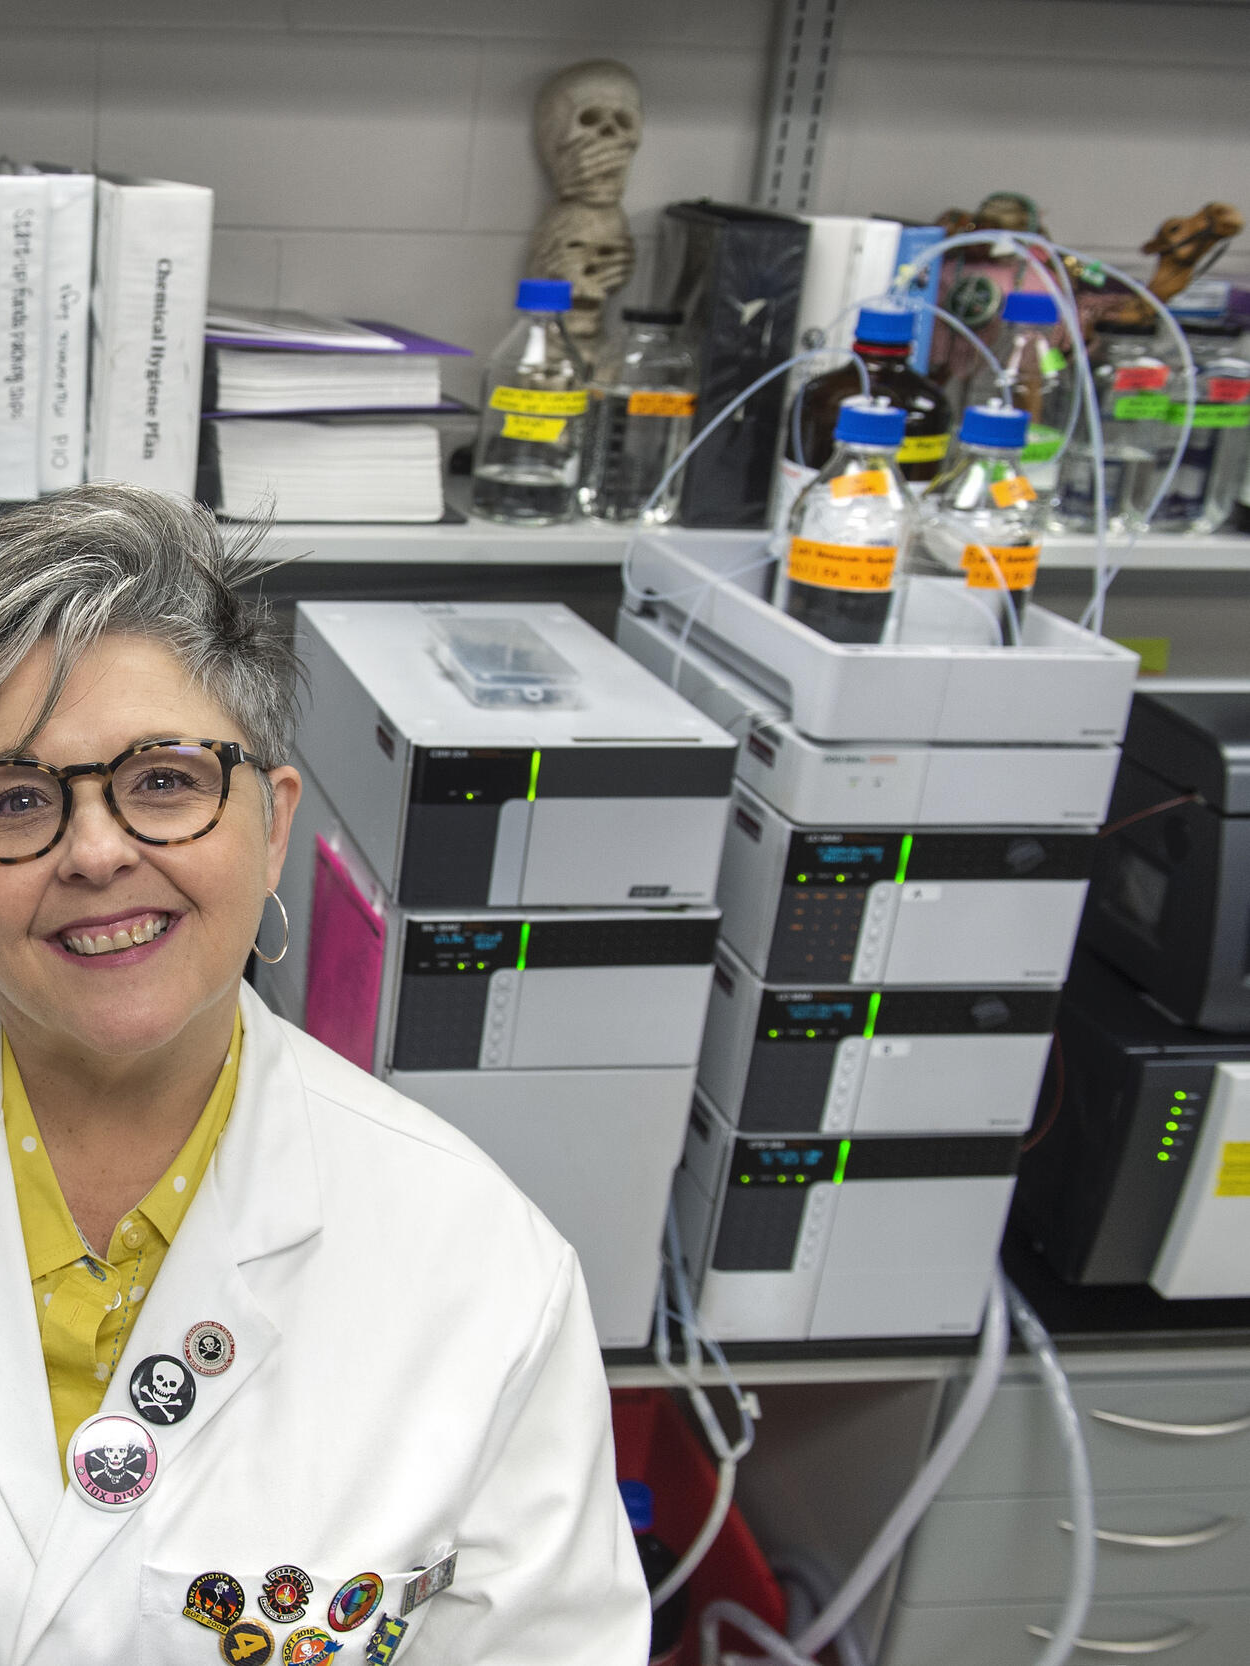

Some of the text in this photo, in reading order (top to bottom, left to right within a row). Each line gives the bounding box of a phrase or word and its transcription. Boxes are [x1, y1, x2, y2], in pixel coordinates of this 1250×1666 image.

[142, 257, 173, 460] Chemical Hygiene Plan
[84, 1480, 145, 1503] TOX DIVA
[270, 1568, 293, 1580] SOFT
[188, 1573, 244, 1604] OKLAHOMA CITY
[185, 1609, 228, 1633] SOFT 2009
[230, 1632, 268, 1662] 4
[284, 1637, 296, 1662] SOFT
